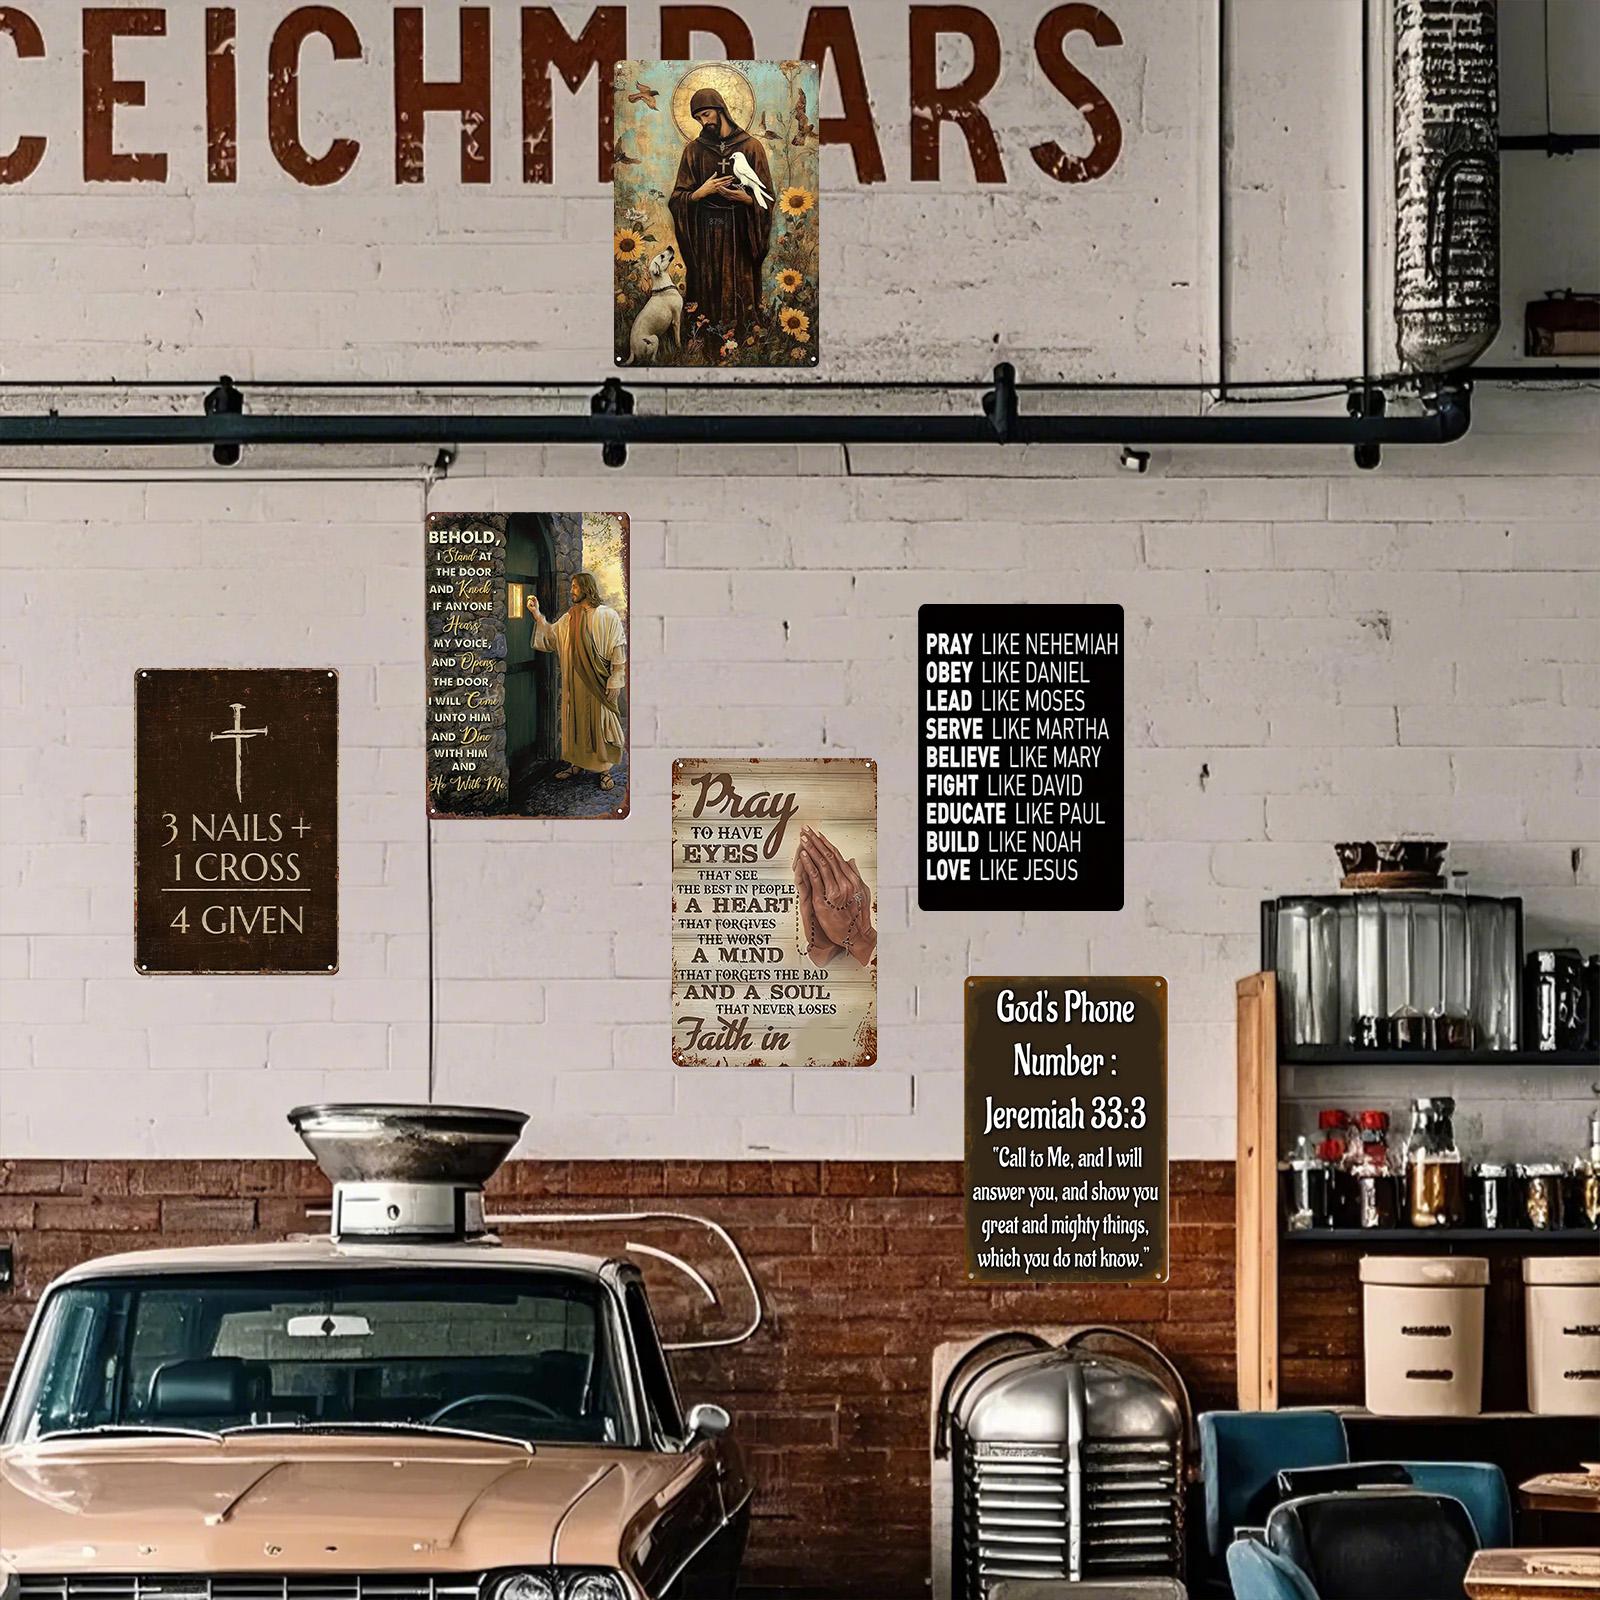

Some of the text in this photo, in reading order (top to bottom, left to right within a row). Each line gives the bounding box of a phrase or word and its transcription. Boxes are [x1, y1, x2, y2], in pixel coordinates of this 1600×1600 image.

[429, 531, 501, 547] BEHOLD,
[437, 547, 492, 564] I Stand AT
[437, 568, 491, 576] THE DOOR
[430, 585, 453, 594] AND
[433, 602, 493, 611] IF ANYONE
[443, 614, 481, 636] Hears
[434, 639, 491, 650] MY VOICE,
[926, 633, 1118, 654] PRAY LIKE NEHEMIAH
[432, 652, 496, 672] AND Opens
[433, 677, 493, 688] THE DOOR,
[926, 662, 1090, 683] OBEY LIKE DANIEL
[429, 691, 499, 709] I WILL Come
[926, 690, 1085, 711] LEAD LIKE MOSES
[435, 713, 490, 722] UNTO HIM
[432, 725, 491, 745] AND Dine
[926, 718, 1109, 739] SERVE LIKE MARTHA
[434, 749, 487, 758] WITH HIM
[926, 746, 1101, 768] BELIEVE LIKE MARY
[452, 762, 476, 771] AND
[430, 775, 507, 794] He With Me.
[926, 775, 1083, 796] FIGHT LIKE DAVID
[691, 772, 799, 859] Pray
[926, 803, 1105, 824] EDUCATE LIKE PAUL
[162, 813, 311, 847] 3 NAILS +
[691, 827, 763, 840] TO HAVE
[926, 831, 1081, 852] BUILD LIKE NOAH
[682, 844, 758, 864] EYES
[174, 852, 300, 881] 1 CROSS
[698, 870, 758, 880] THAT SEE
[926, 859, 1078, 880] LOVE LIKE JESUS
[677, 885, 796, 895] THE BEST IN PEOPLE
[685, 897, 793, 913] A HEART
[170, 906, 303, 934] 4 GIVEN
[679, 919, 776, 930] THAT FORGIVES
[697, 934, 771, 946] THE WORST
[691, 947, 784, 963] A MIND
[679, 969, 828, 982] THAT FORGETS THE BAD
[683, 984, 830, 1000] AND A SOUL
[716, 1004, 836, 1017] THAT NEVER LOSES
[996, 989, 1135, 1023] God's Phone
[677, 1016, 790, 1051] Faith in
[1013, 1042, 1104, 1077] Number
[984, 1096, 1146, 1134] Jeremiah 33:3
[1030, 1150, 1044, 1168] to
[1048, 1146, 1074, 1170] Me,
[1078, 1147, 1104, 1168] and
[1108, 1147, 1112, 1168] I
[1116, 1147, 1142, 1168] will
[973, 1181, 1159, 1208] answer you, and show you
[981, 1214, 1149, 1242] great and mighty things,
[977, 1246, 1021, 1268] which
[1023, 1252, 1050, 1274] you
[1053, 1246, 1071, 1268] do
[1074, 1249, 1097, 1268] not
